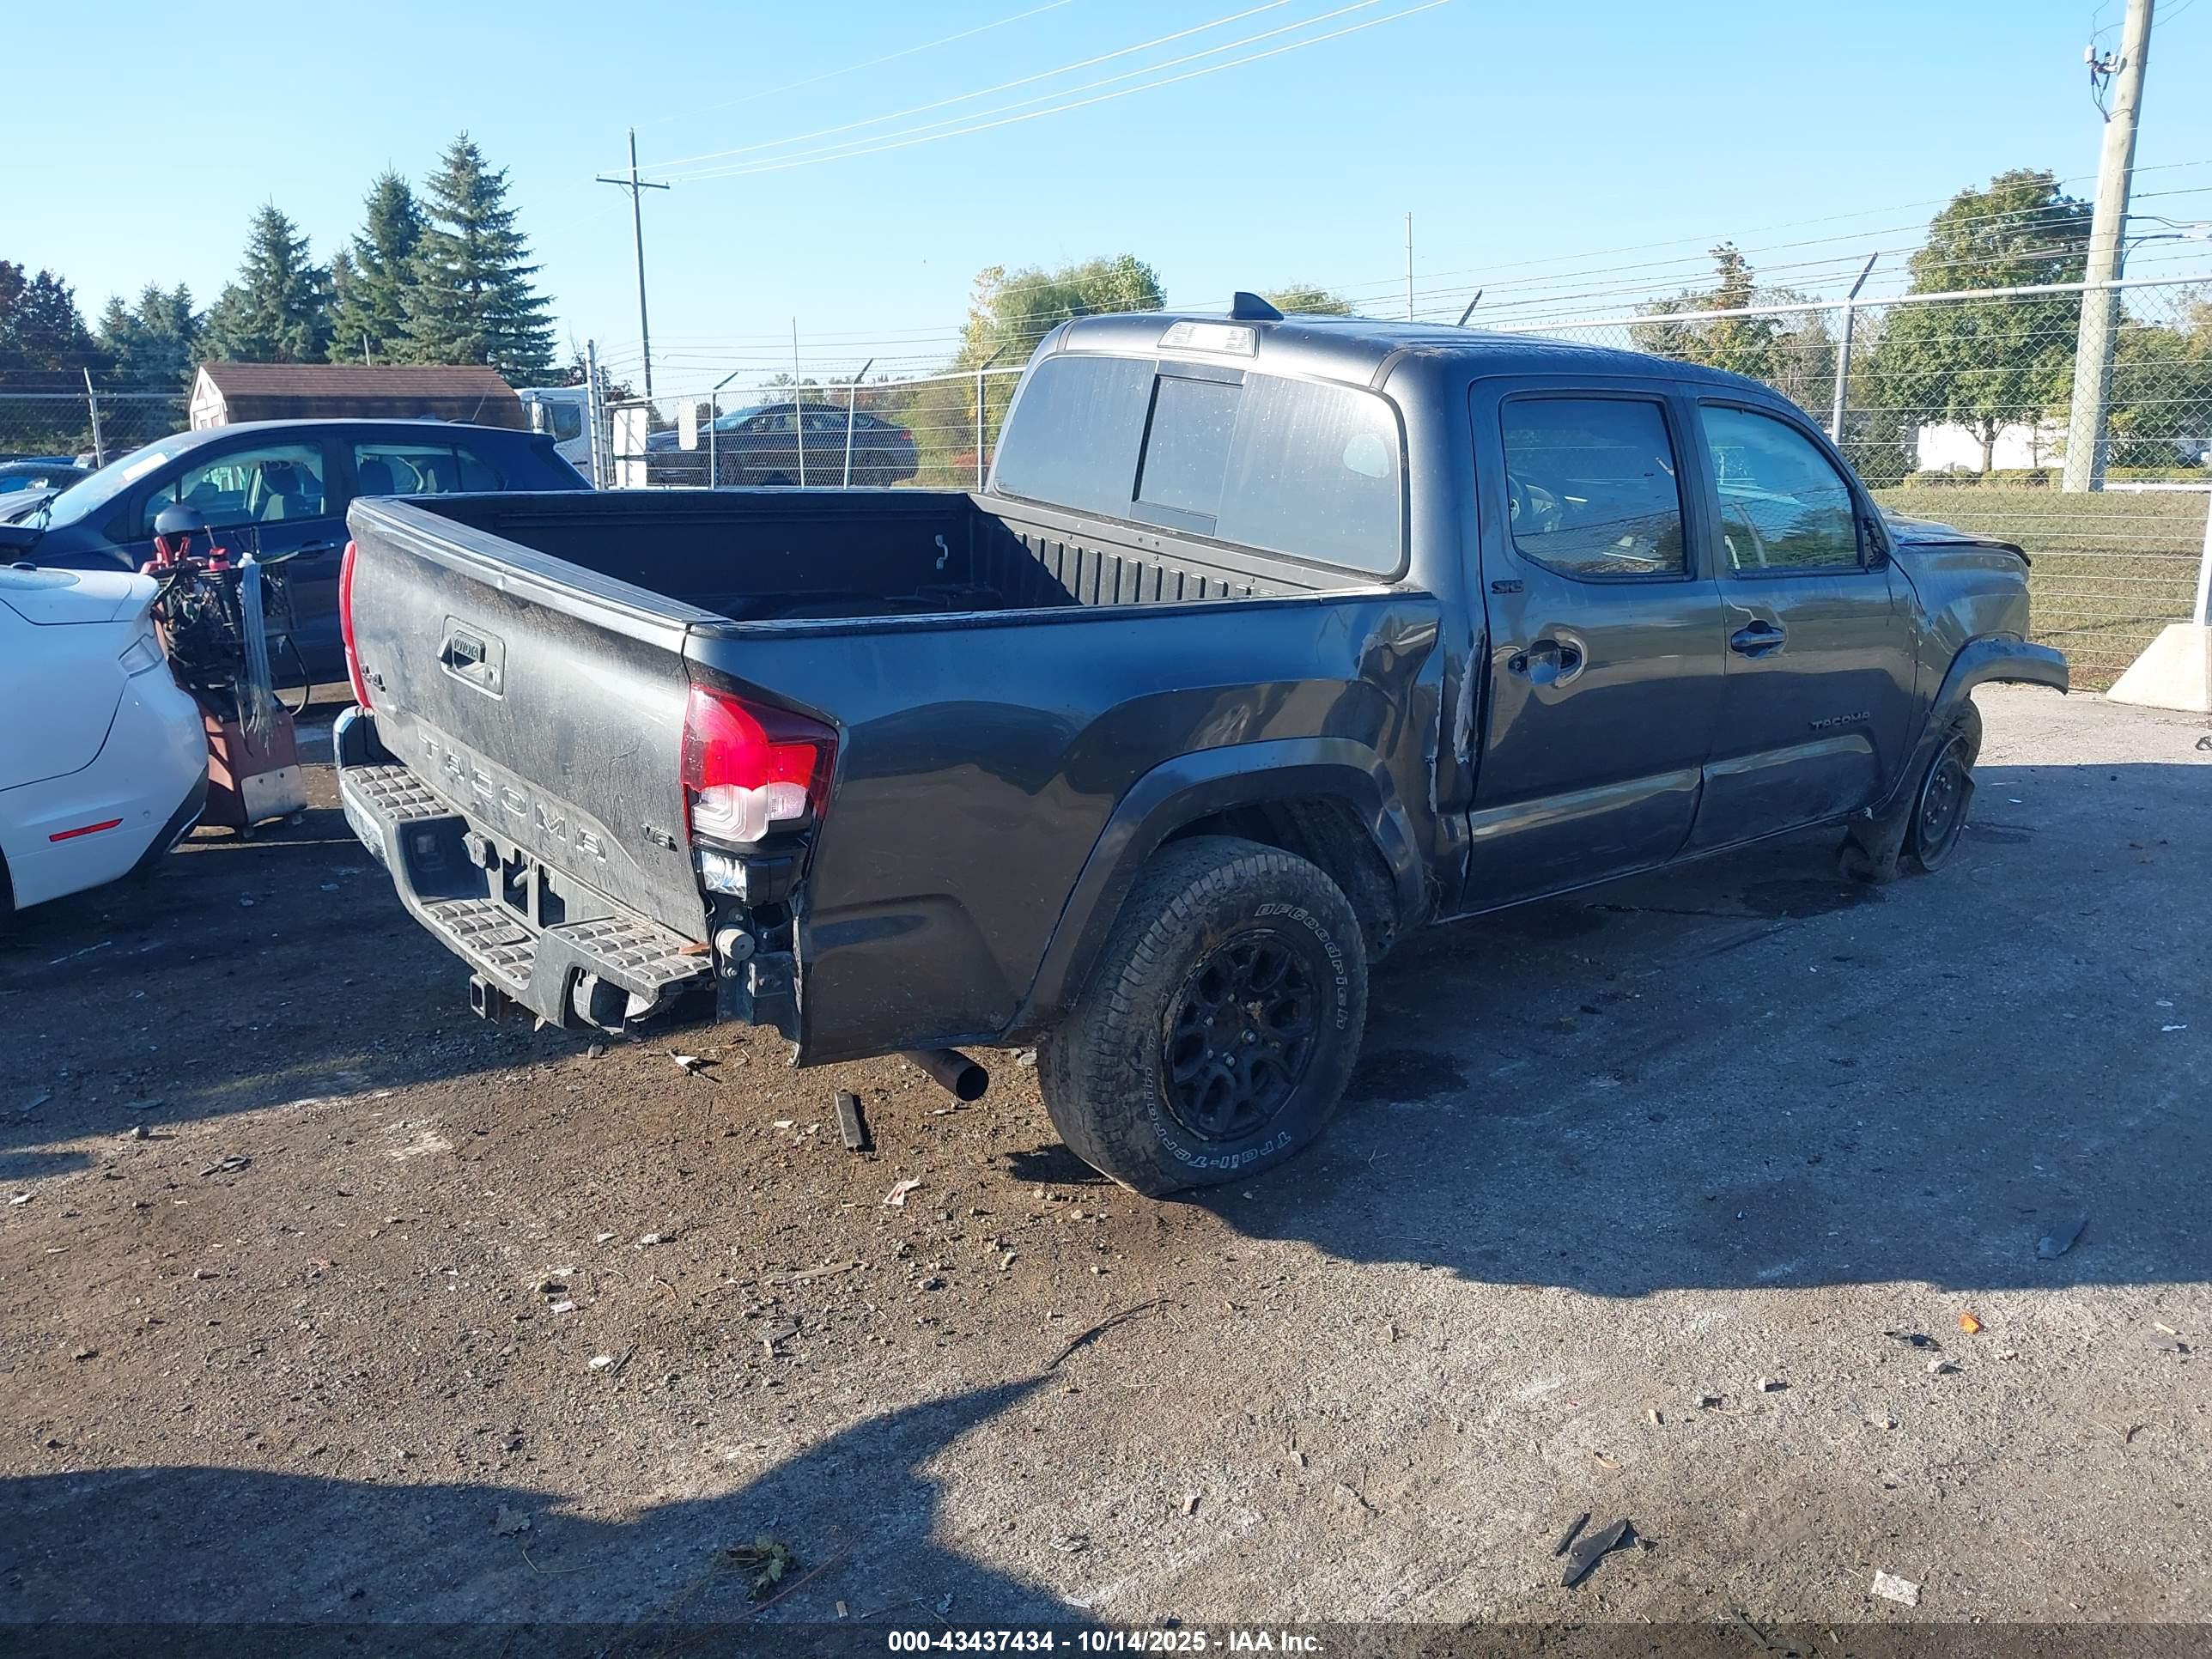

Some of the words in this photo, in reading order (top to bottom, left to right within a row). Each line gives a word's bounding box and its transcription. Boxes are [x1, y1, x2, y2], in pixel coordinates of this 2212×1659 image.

[453, 637, 479, 660] TOYOTA
[1808, 709, 1870, 729] TACOMA
[417, 728, 606, 863] TACOMA
[641, 822, 678, 853] V6
[1254, 903, 1349, 1030] BFGoodrich
